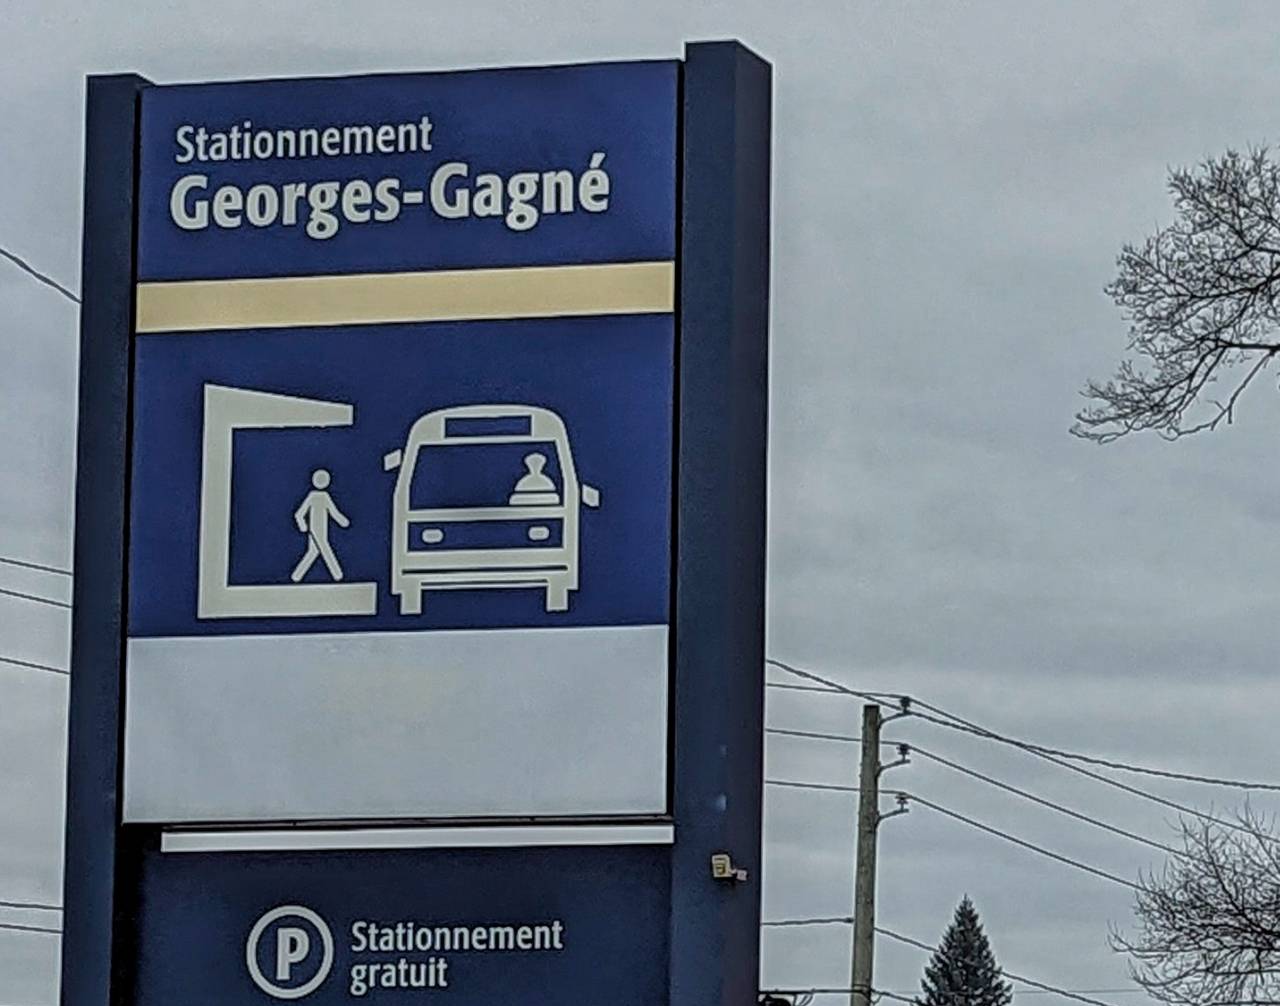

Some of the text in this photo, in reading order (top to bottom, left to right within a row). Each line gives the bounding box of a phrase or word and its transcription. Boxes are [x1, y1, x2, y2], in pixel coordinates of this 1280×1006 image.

[174, 115, 433, 163] Stationnement
[169, 151, 611, 239] Georges-Gagné
[275, 926, 311, 981] P
[350, 920, 564, 952] Stationnement
[349, 956, 449, 997] gratuit
